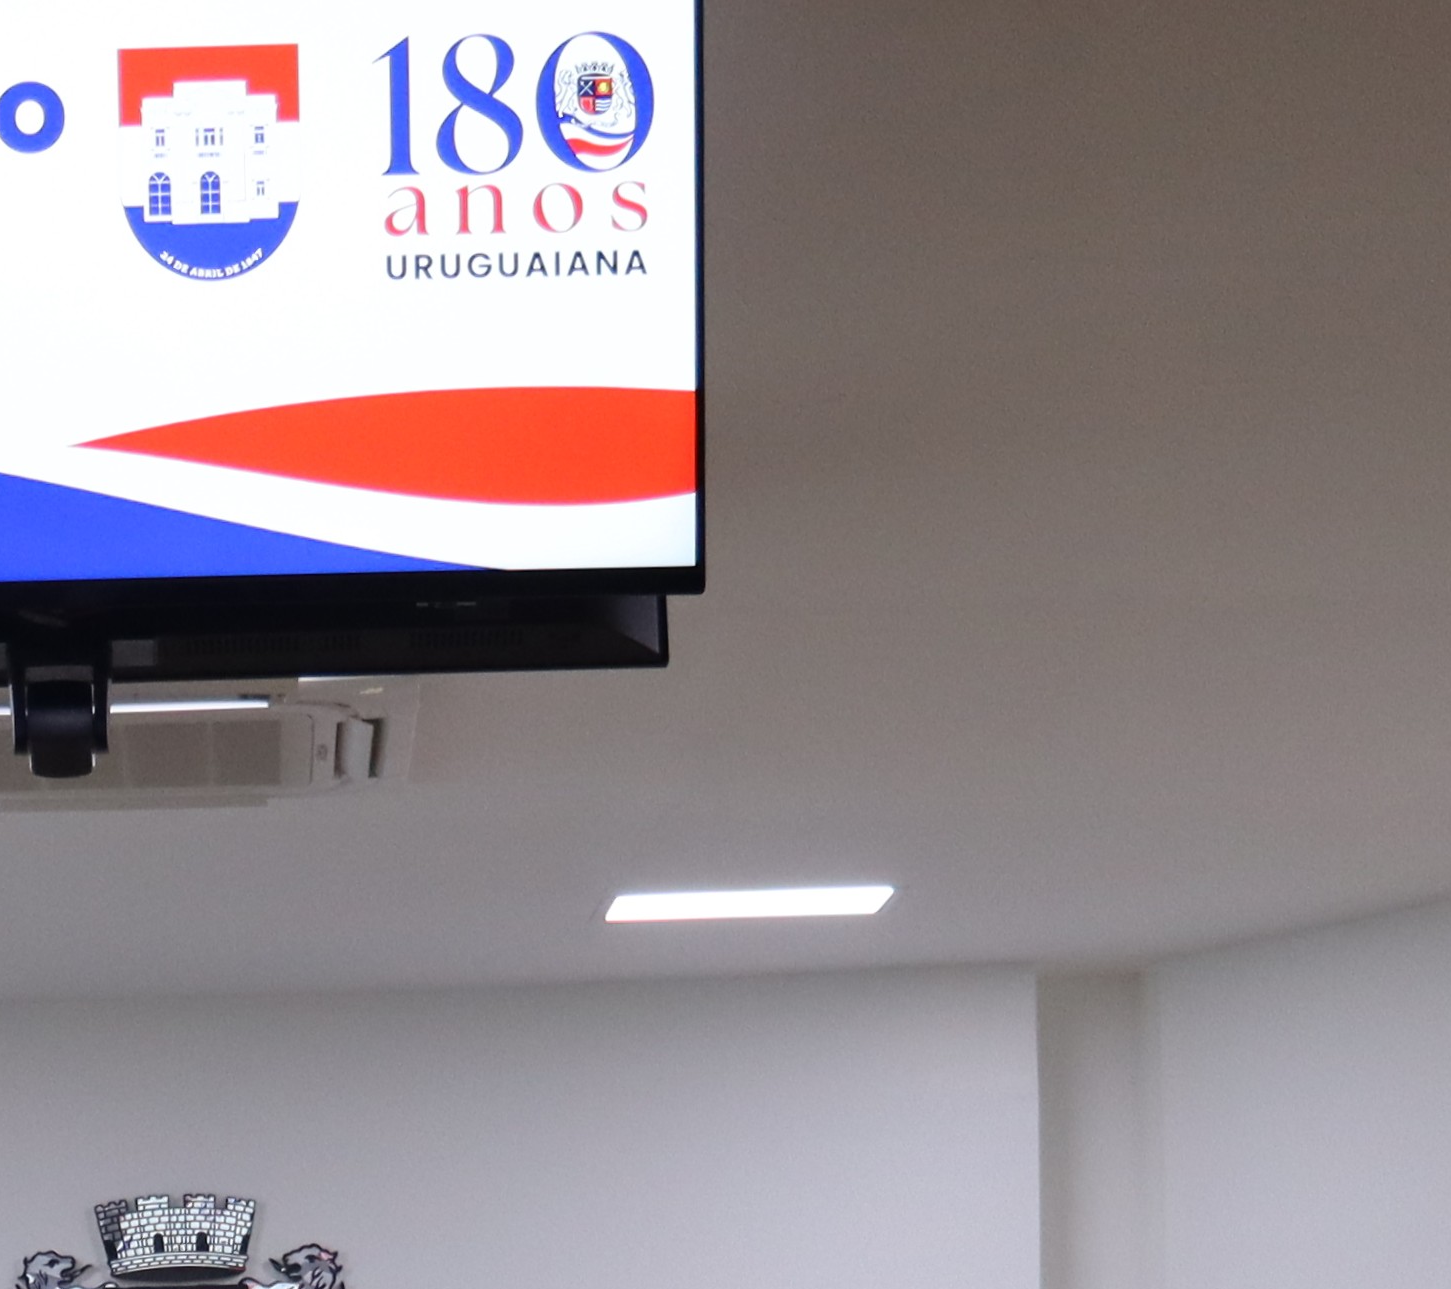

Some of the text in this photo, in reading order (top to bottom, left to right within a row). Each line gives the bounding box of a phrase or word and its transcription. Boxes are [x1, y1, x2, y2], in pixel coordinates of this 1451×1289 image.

[372, 31, 655, 176] 180
[384, 181, 648, 237] anos
[386, 249, 648, 279] URUGUAIANA
